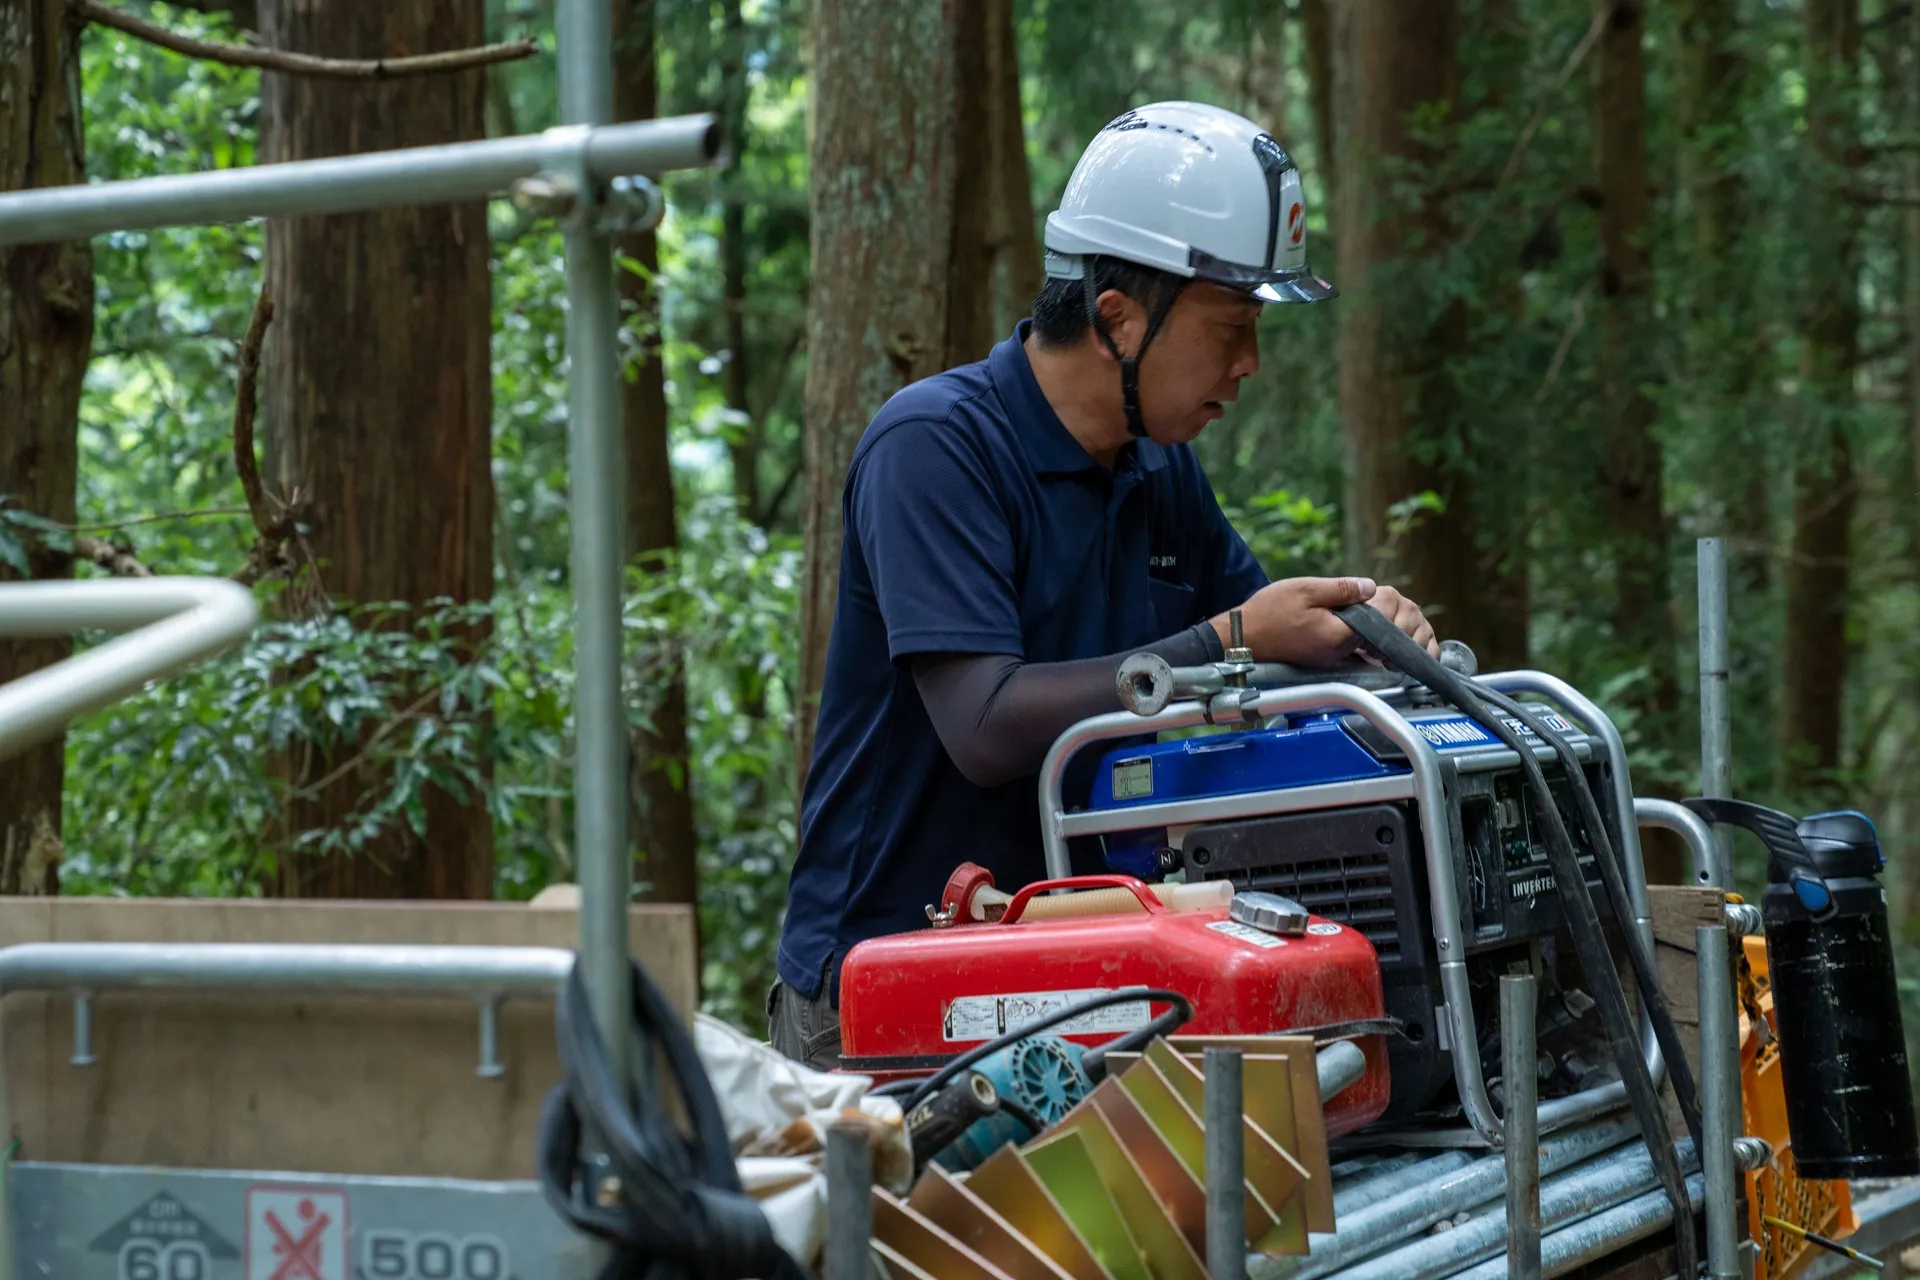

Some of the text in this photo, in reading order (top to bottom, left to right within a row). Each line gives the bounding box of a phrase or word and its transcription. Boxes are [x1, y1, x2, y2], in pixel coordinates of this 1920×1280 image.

[1427, 721, 1489, 744] YAMAHA
[122, 1243, 207, 1280] 60
[367, 1233, 504, 1280] 500
